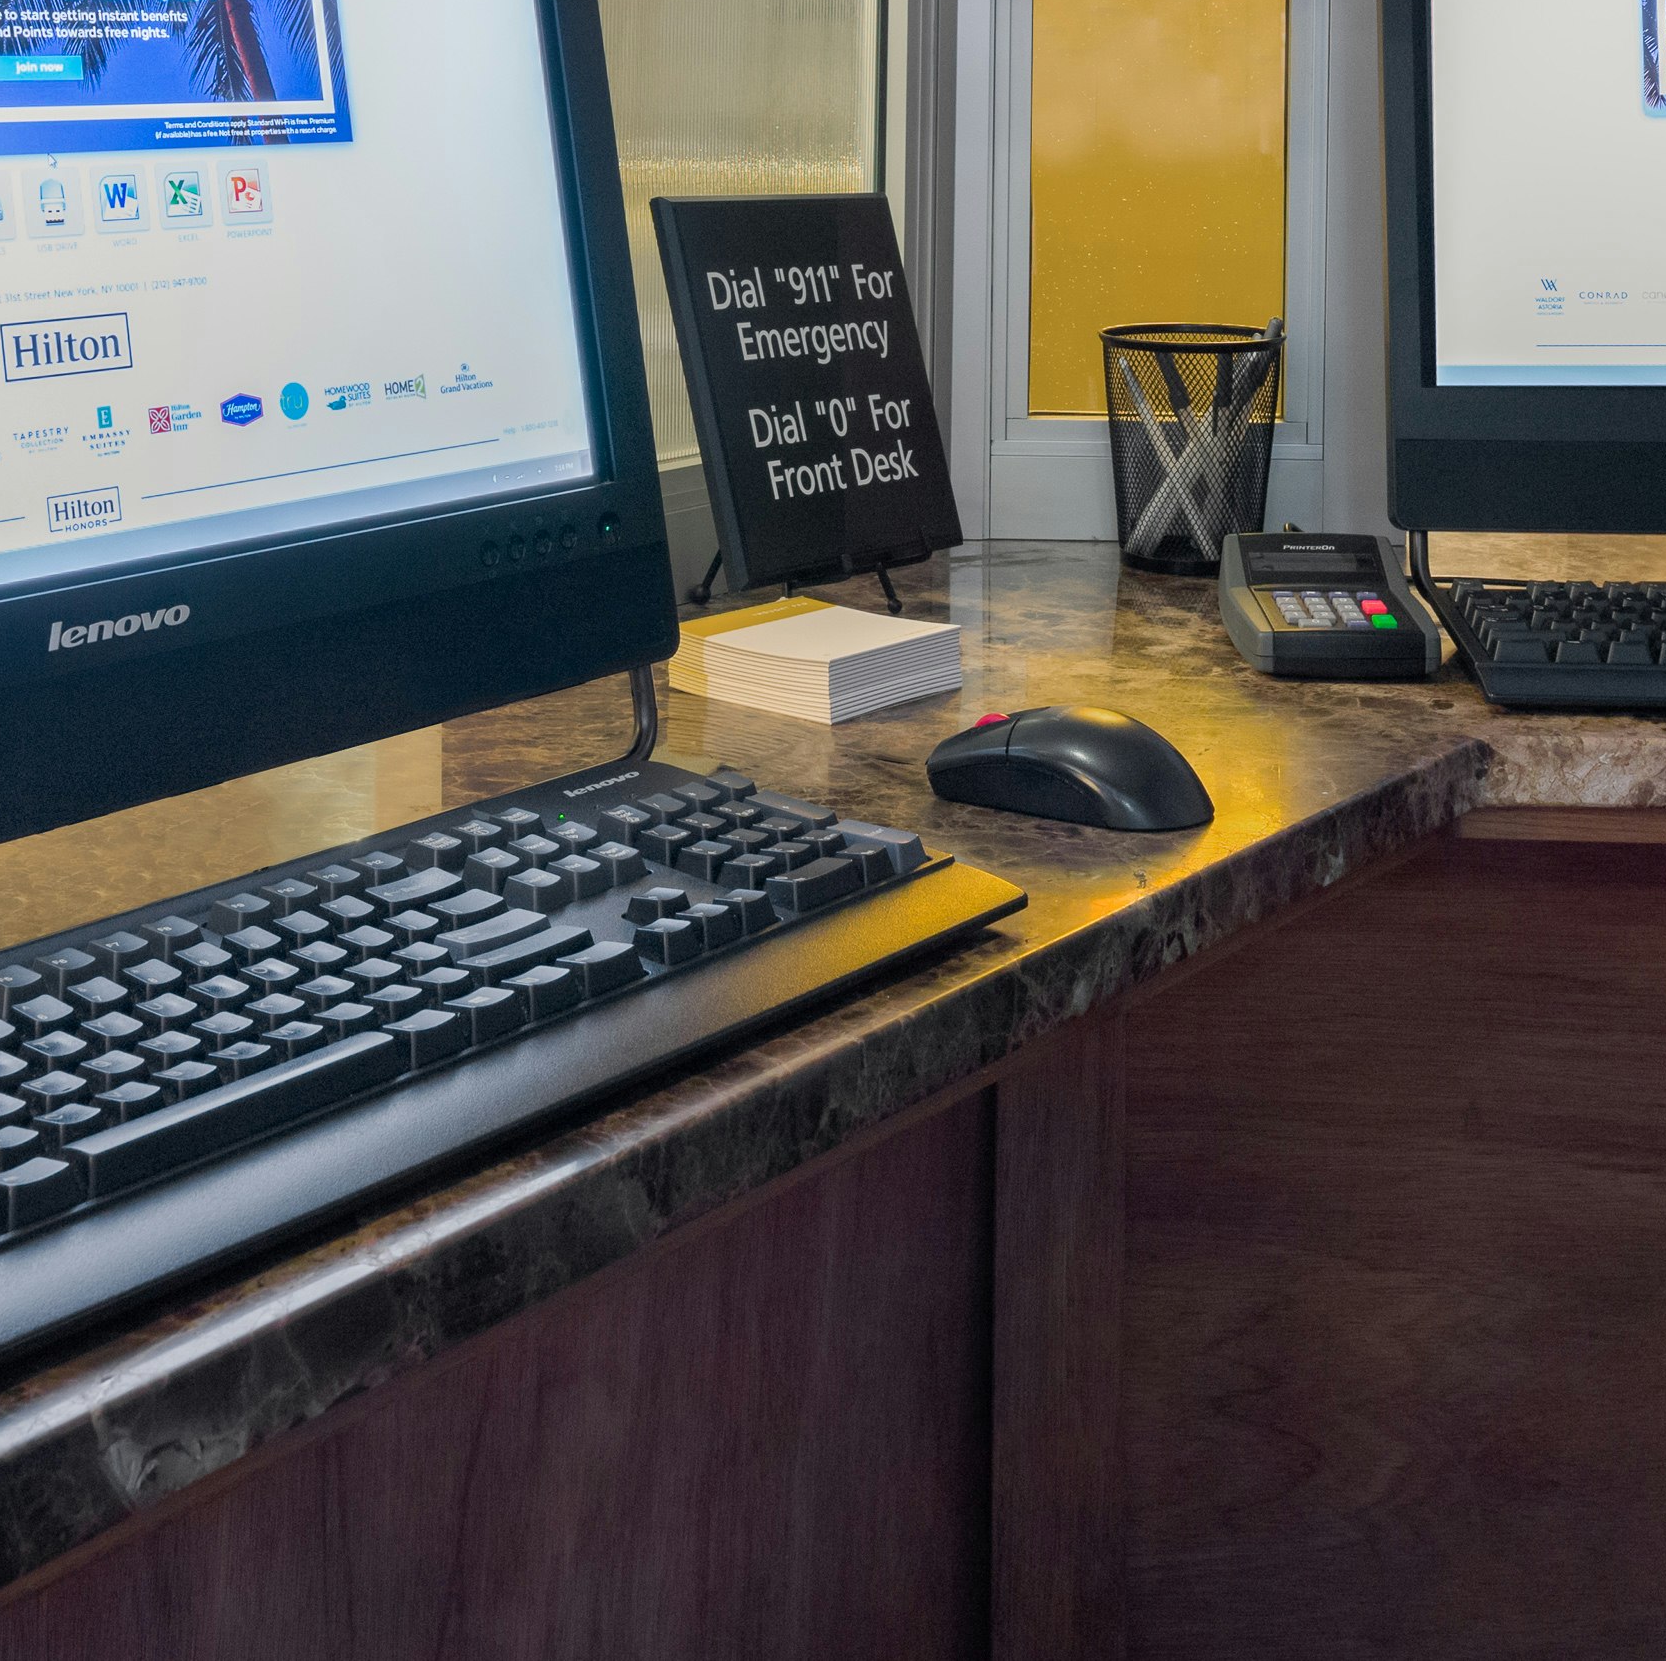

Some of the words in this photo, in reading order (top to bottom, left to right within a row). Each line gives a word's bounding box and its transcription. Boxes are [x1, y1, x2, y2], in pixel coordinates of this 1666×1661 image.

[4, 9, 18, 21] to
[20, 10, 50, 22] start
[52, 9, 97, 24] getting
[98, 9, 140, 22] instant
[140, 9, 188, 23] benefits
[13, 25, 54, 39] Points
[55, 26, 104, 39] towards
[104, 25, 129, 39] free
[130, 25, 170, 41] nights.
[24, 290, 51, 301] Street
[53, 288, 74, 299] New
[707, 265, 767, 311] Dial
[774, 264, 841, 305] "911"
[851, 263, 894, 301] For
[1579, 291, 1628, 300] CONRAD
[12, 328, 123, 369] Hilton
[736, 318, 889, 365] Emergency
[455, 373, 477, 383] Hilton
[324, 382, 371, 396] HOMEWOOD
[440, 384, 461, 395] Grand
[461, 379, 494, 391] Vacations
[348, 391, 372, 402] SUITES
[171, 410, 202, 421] Garden
[223, 401, 261, 417] Hampton
[748, 400, 808, 449] Dial
[815, 396, 857, 438] "0"
[868, 393, 911, 432] For
[12, 426, 70, 441] TAPESTRY
[767, 452, 847, 500] Front
[850, 439, 919, 487] Desk
[53, 497, 115, 522] Hilton
[65, 518, 108, 533] HONORS
[47, 603, 191, 653] lenovo
[563, 770, 641, 799] lenovo
